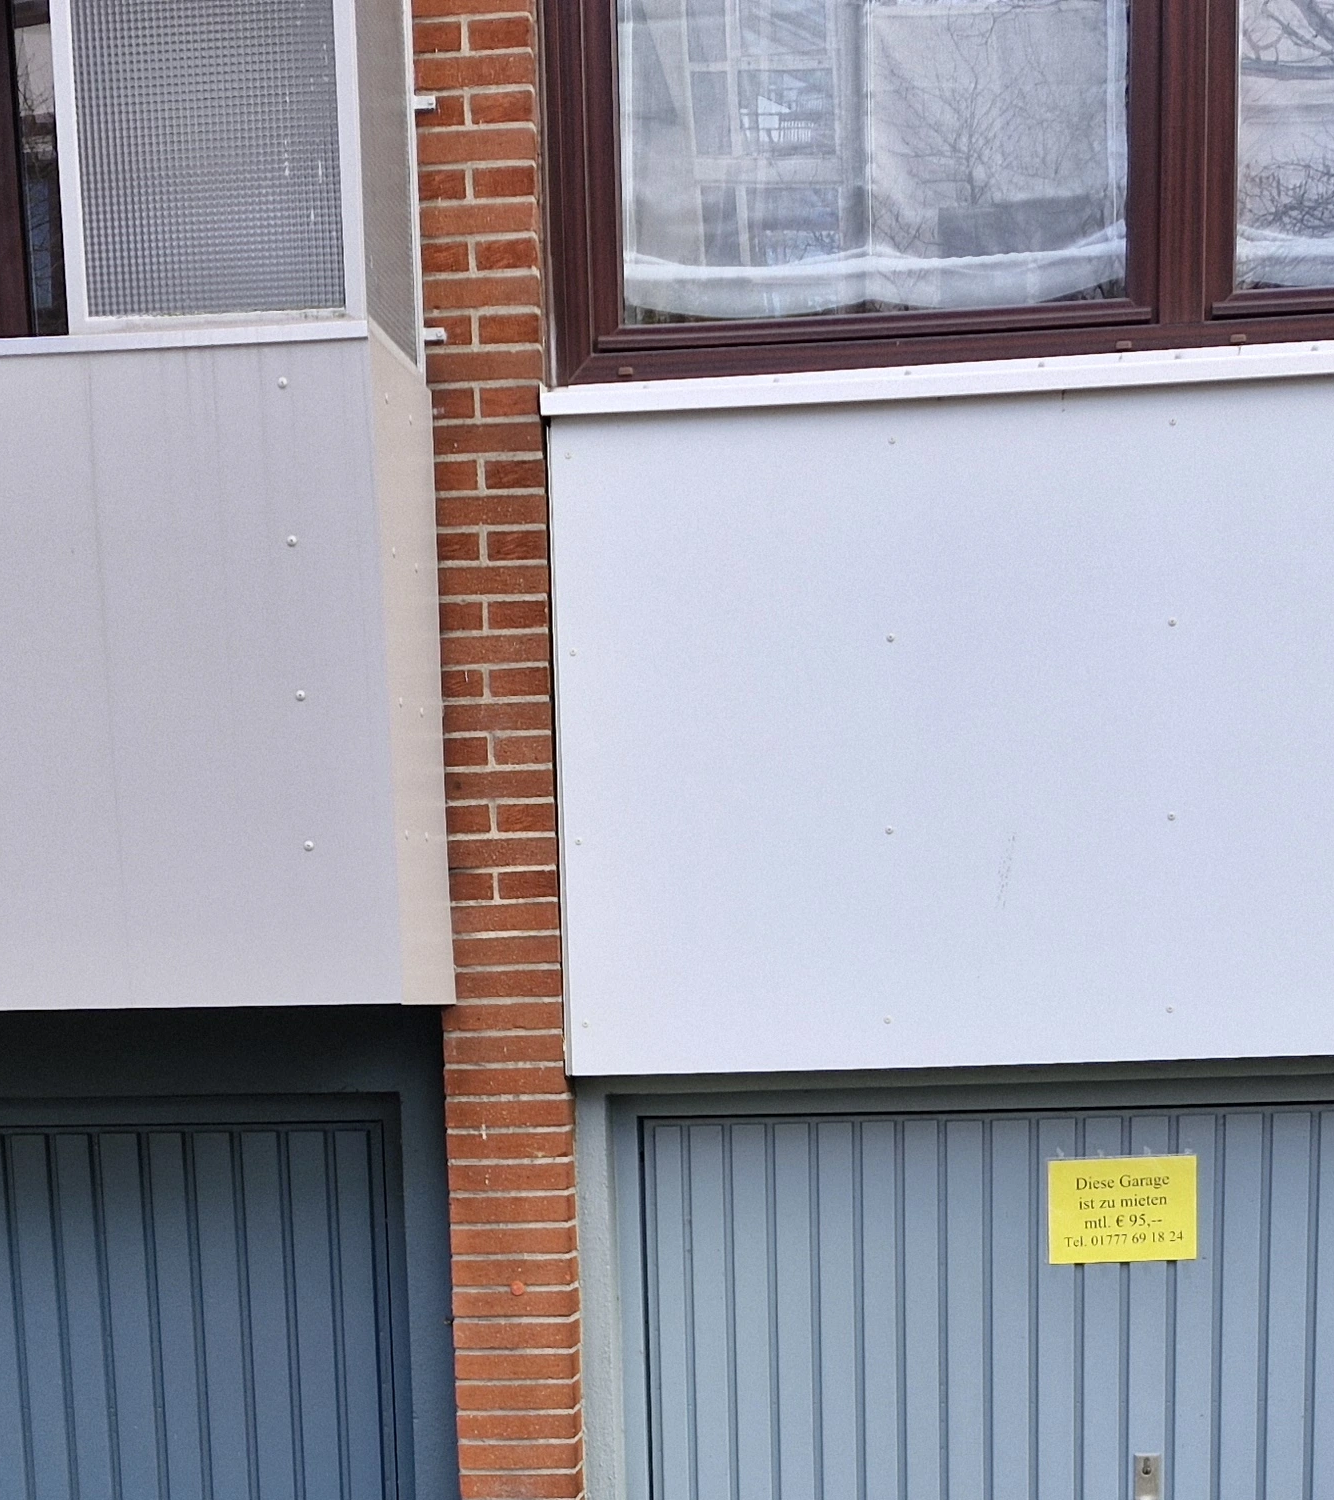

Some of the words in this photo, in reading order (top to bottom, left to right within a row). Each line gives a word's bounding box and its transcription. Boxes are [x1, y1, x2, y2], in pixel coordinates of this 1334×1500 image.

[1076, 1176, 1115, 1191] Diese
[1119, 1174, 1170, 1189] Garage
[1079, 1196, 1095, 1210] ist
[1099, 1199, 1116, 1209] zu
[1120, 1193, 1168, 1207] mieten
[1084, 1215, 1111, 1230] mtl.
[1116, 1214, 1125, 1228] €
[1064, 1235, 1087, 1248] Tel.
[1091, 1233, 1128, 1247] 01777
[1131, 1232, 1147, 1244] 69
[1152, 1231, 1165, 1243] 18
[1169, 1230, 1184, 1242] 24
